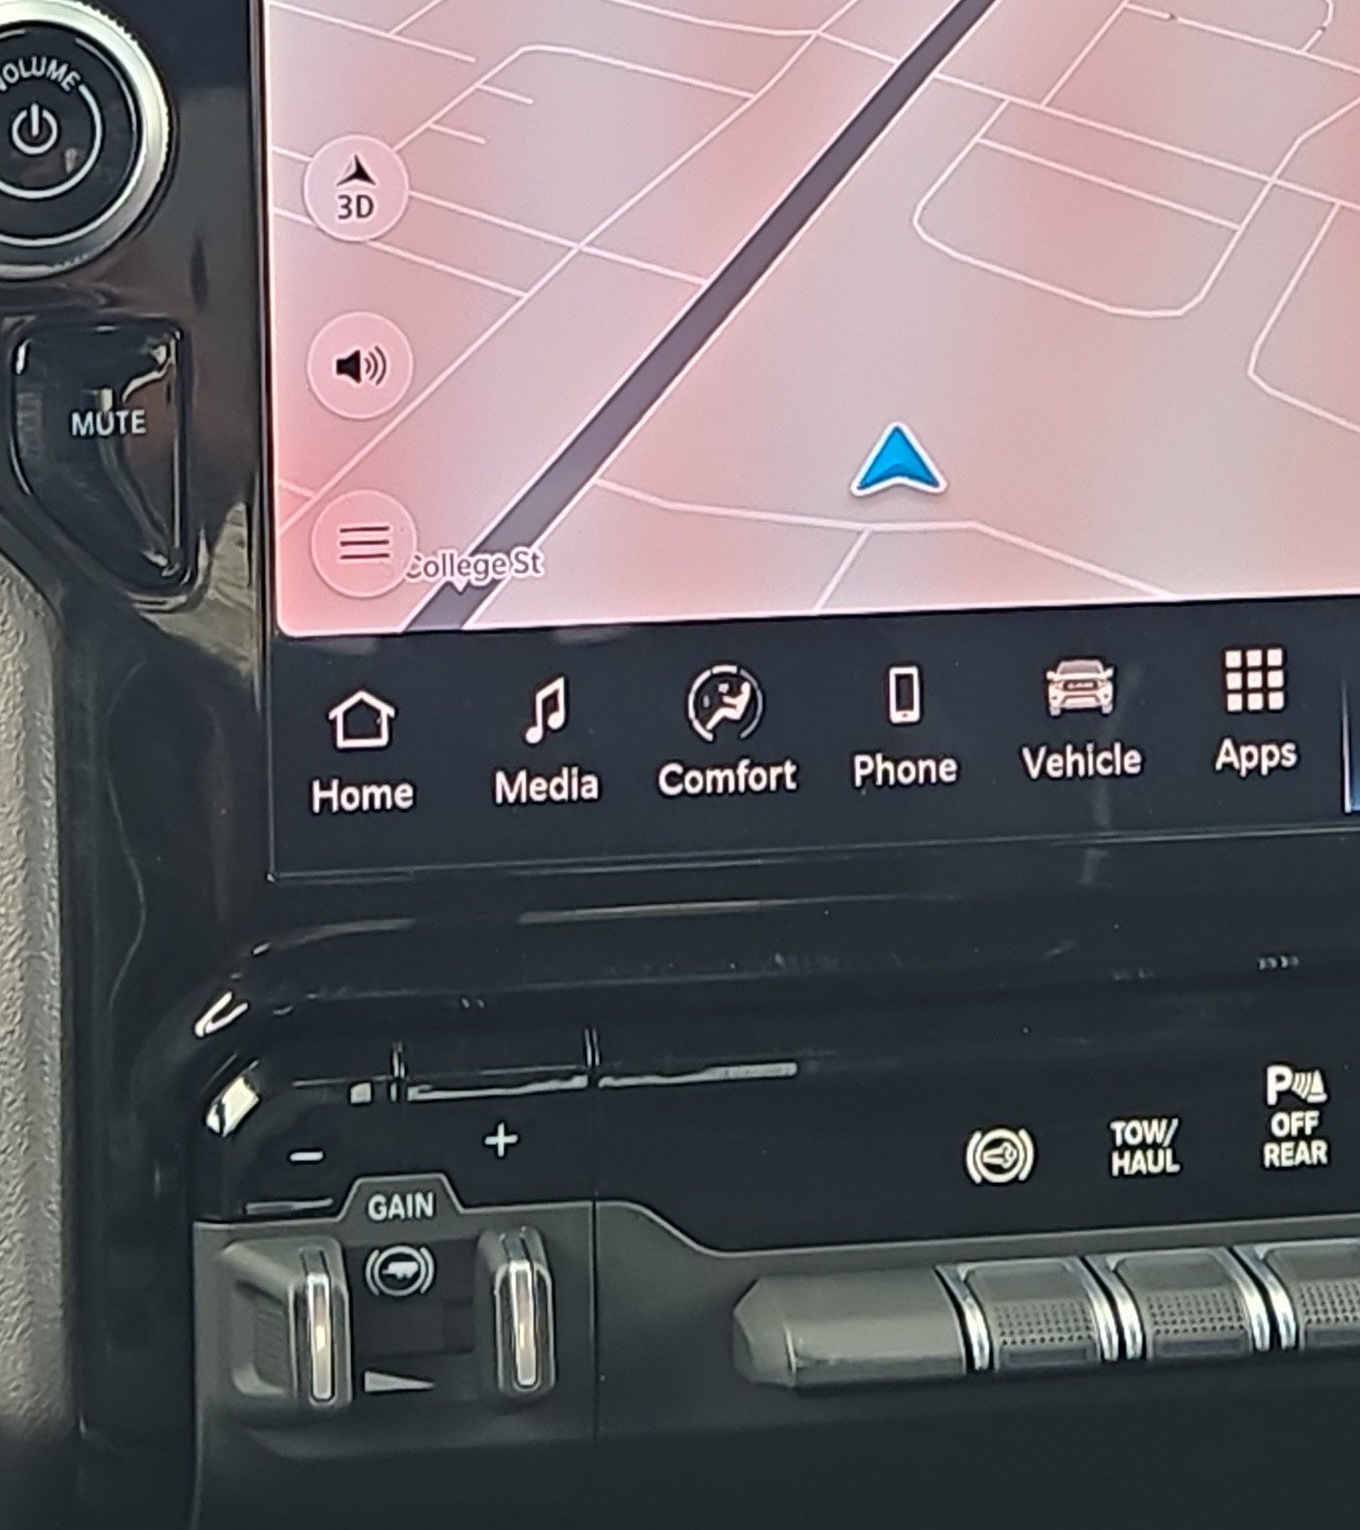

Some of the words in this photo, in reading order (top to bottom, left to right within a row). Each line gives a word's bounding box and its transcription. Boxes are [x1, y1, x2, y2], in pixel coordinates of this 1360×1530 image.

[337, 194, 375, 220] 3D
[71, 409, 148, 437] MUTE
[513, 550, 541, 574] St
[853, 752, 958, 788] Phone
[1021, 742, 1142, 780] Vehicle
[1215, 737, 1297, 779] Apps
[494, 767, 600, 805] Media
[657, 757, 798, 797] Comfort
[311, 778, 415, 814] Home
[1110, 1118, 1180, 1147] TOW/
[1270, 1111, 1319, 1138] OFF
[1110, 1147, 1180, 1178] HAUL
[1263, 1140, 1328, 1169] REAR
[367, 1191, 436, 1221] GAIN
